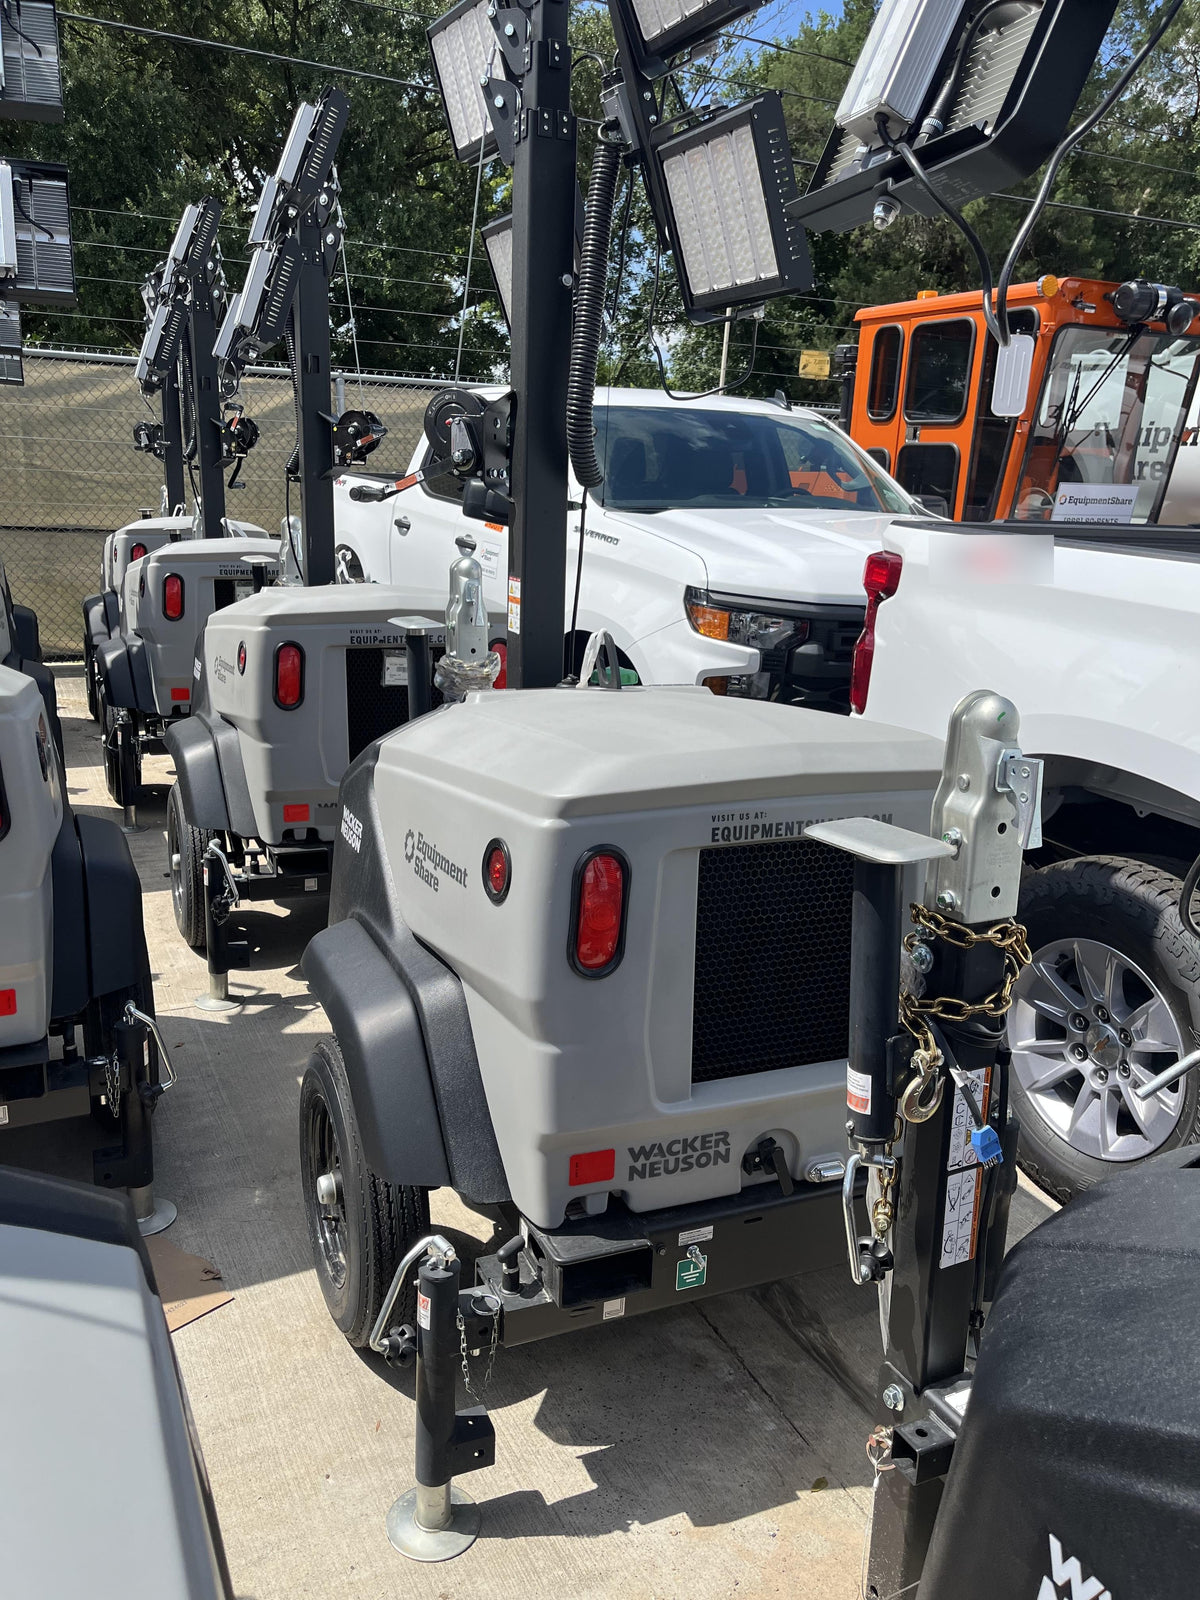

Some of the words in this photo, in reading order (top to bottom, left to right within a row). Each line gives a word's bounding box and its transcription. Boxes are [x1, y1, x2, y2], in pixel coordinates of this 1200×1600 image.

[1067, 495, 1133, 506] EquipmentShare
[573, 525, 620, 546] SVERADO
[342, 804, 363, 838] WACKER
[711, 813, 735, 822] VISIT
[739, 812, 750, 821] US
[754, 811, 767, 820] AT:
[341, 820, 361, 854] NEUSON
[414, 855, 439, 892] Share
[416, 831, 468, 888] Equipment
[627, 1131, 731, 1163] WACKER
[628, 1147, 731, 1181] NEUSON
